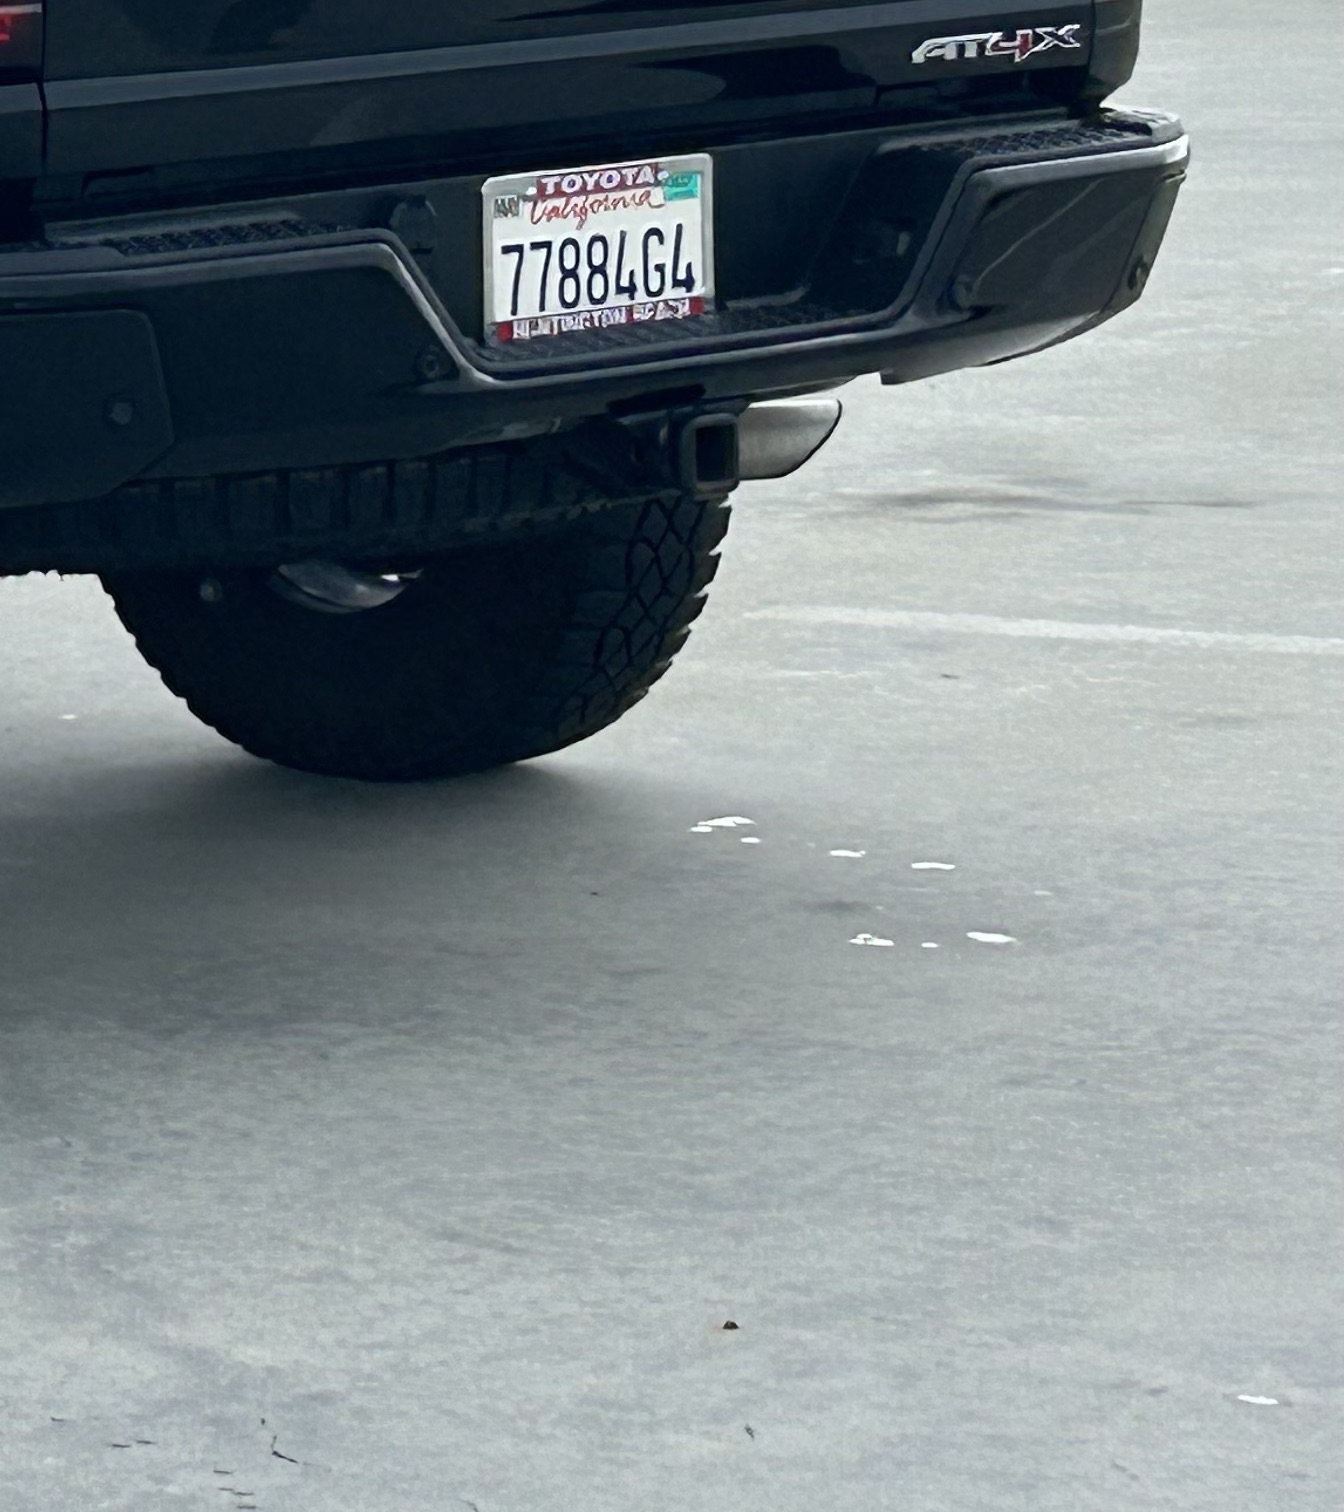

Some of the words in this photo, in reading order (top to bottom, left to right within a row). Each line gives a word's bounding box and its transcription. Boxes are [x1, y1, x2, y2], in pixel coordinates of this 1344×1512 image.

[911, 24, 1081, 64] AT4X
[541, 165, 656, 195] TOYOTA
[531, 188, 665, 230] California
[500, 223, 695, 317] 77884G4
